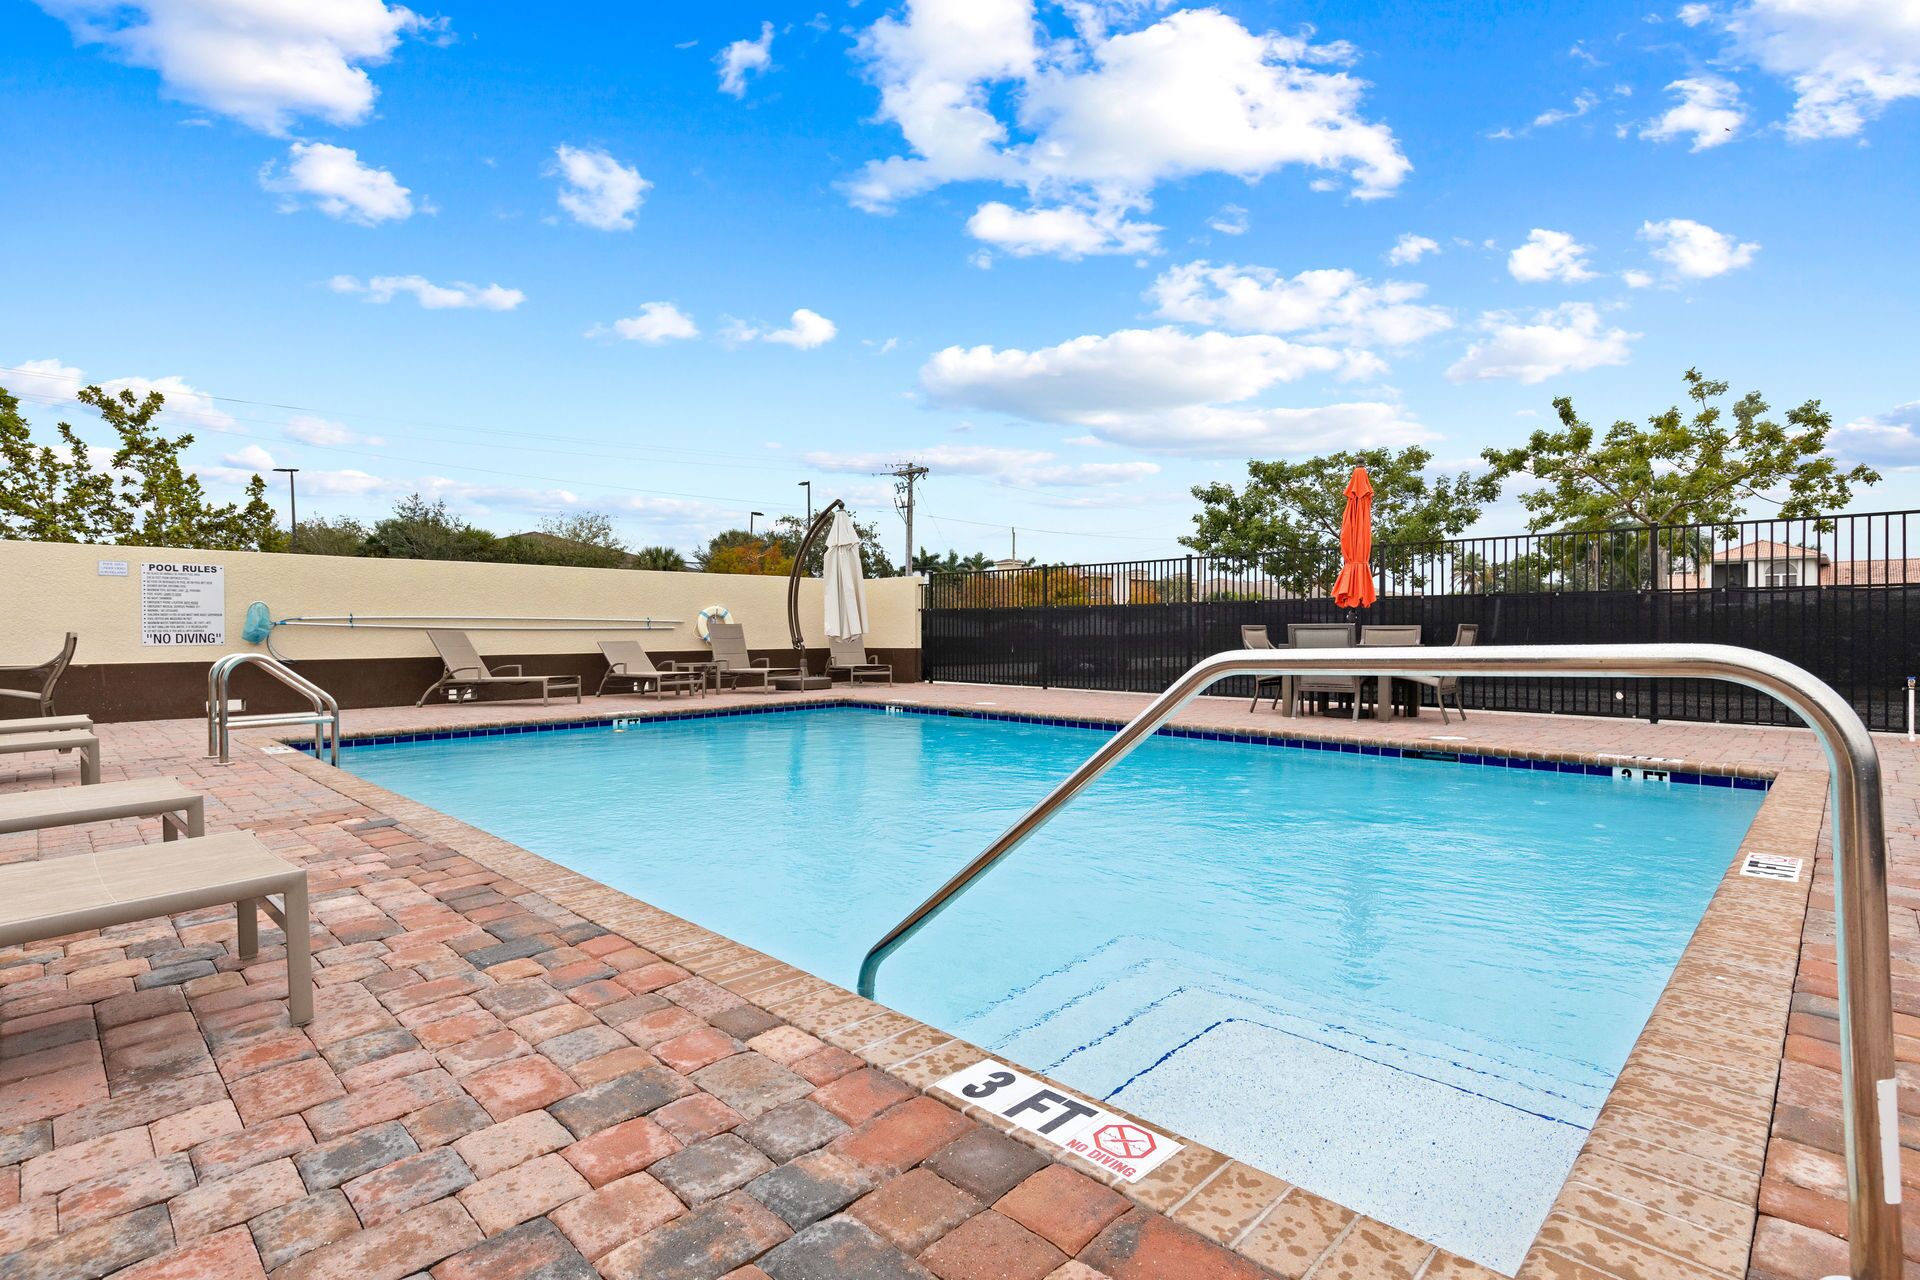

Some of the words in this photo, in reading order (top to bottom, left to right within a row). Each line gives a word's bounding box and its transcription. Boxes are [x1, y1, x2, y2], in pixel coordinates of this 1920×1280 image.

[149, 563, 179, 572] POOL
[182, 565, 217, 573] RULES
[146, 633, 171, 644] "NO
[175, 633, 221, 644] DIVING"
[961, 1071, 1017, 1099] 3
[1003, 1088, 1100, 1135] FT
[1066, 1138, 1089, 1154] NO
[1087, 1148, 1137, 1178] DIVING
